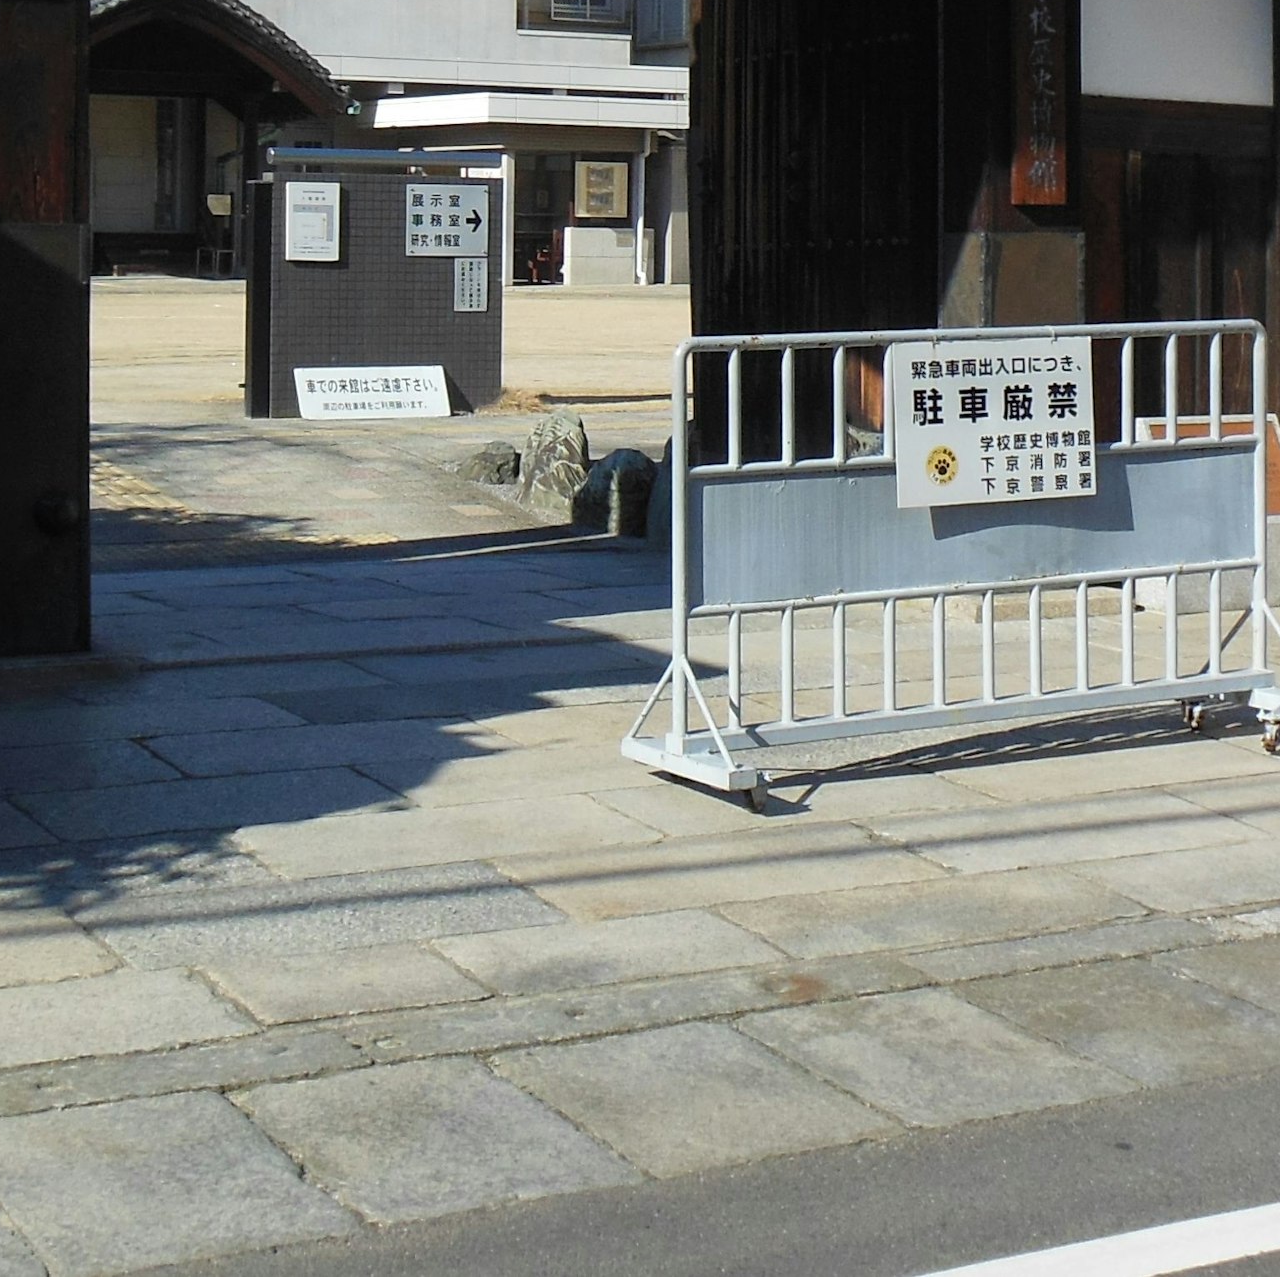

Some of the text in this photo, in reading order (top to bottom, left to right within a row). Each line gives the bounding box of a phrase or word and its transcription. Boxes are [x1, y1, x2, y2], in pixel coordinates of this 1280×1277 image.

[411, 193, 461, 208] 展示室
[411, 213, 461, 227] 事務室
[911, 355, 1082, 380] 緊急車両出入口につき、
[305, 377, 439, 394] 車での来館はご遠慮下さい。
[912, 382, 1078, 427] 駐車厳禁
[980, 430, 1092, 452] 学校歴史博物館
[980, 451, 1092, 474] 下京消防署
[981, 472, 1093, 496] 下京警察署
